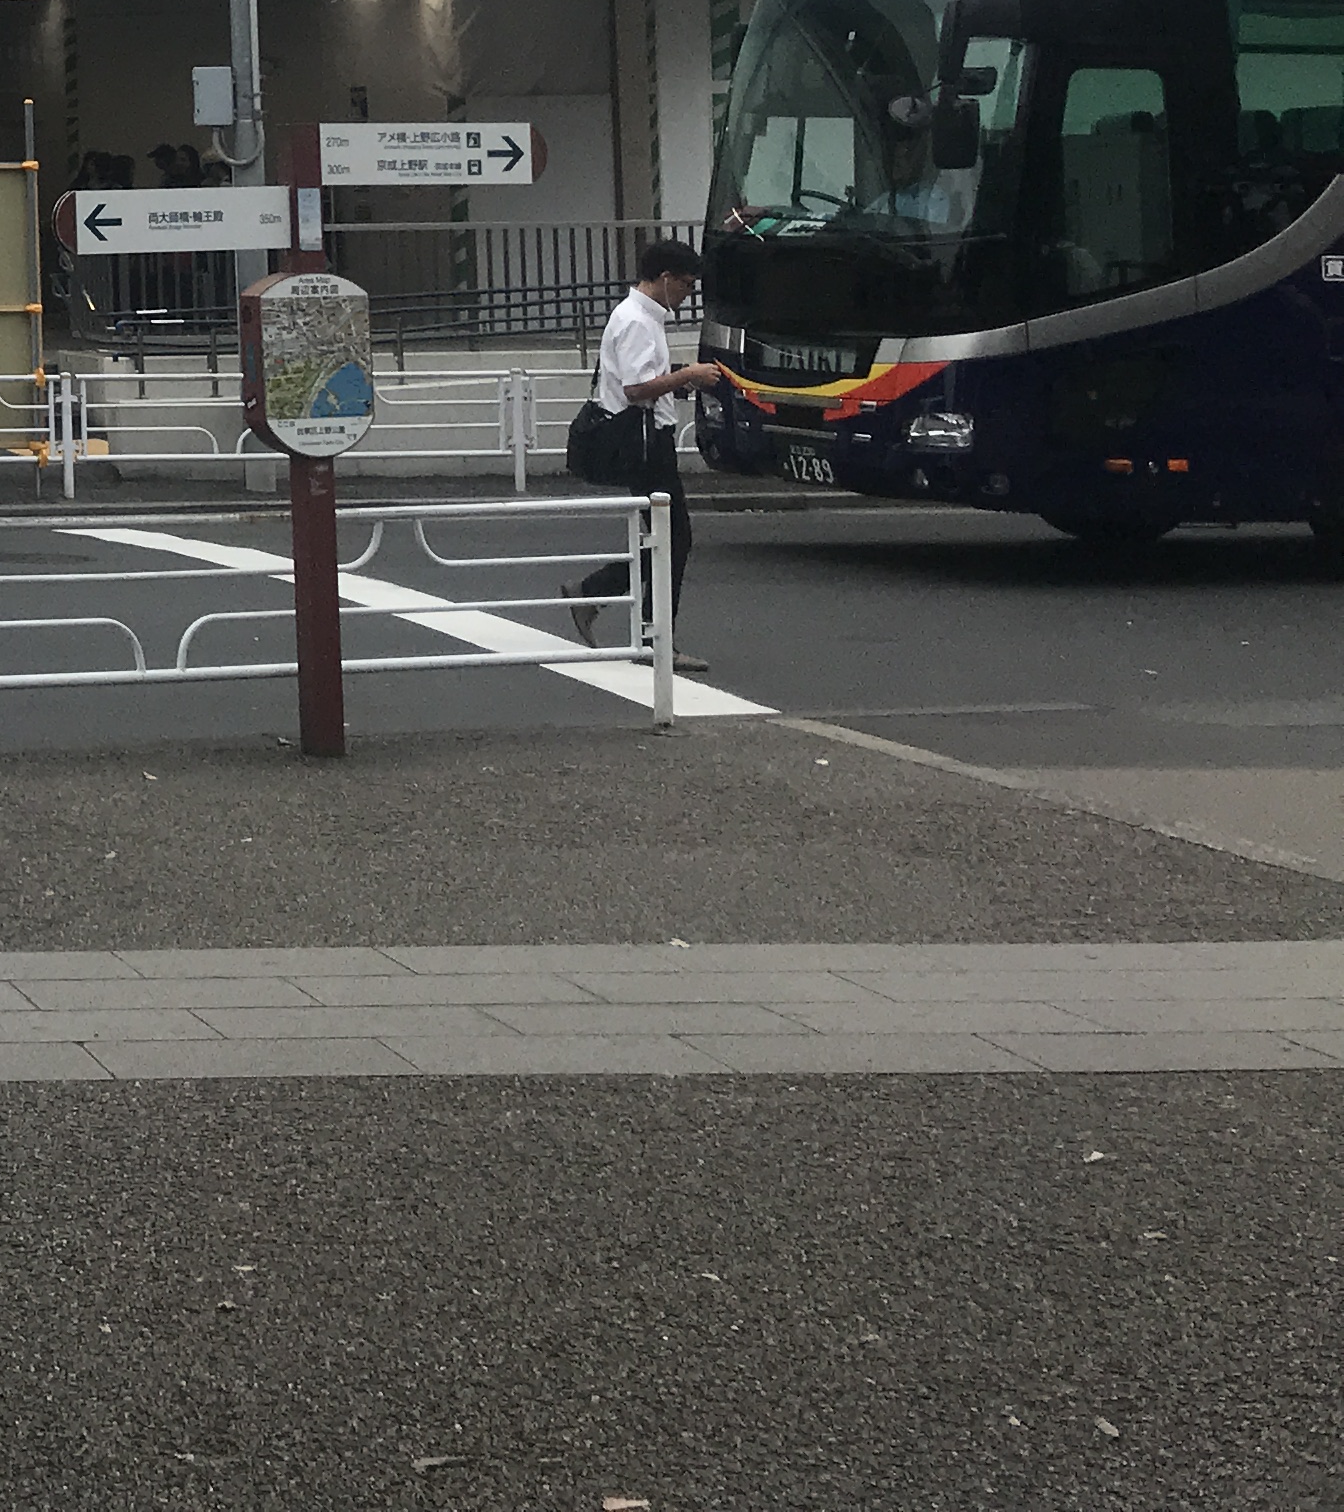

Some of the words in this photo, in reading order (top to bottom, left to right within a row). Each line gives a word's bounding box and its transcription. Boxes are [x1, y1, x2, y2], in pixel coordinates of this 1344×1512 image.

[325, 137, 350, 148] 270m
[327, 164, 350, 175] 300m
[315, 277, 331, 285] Map
